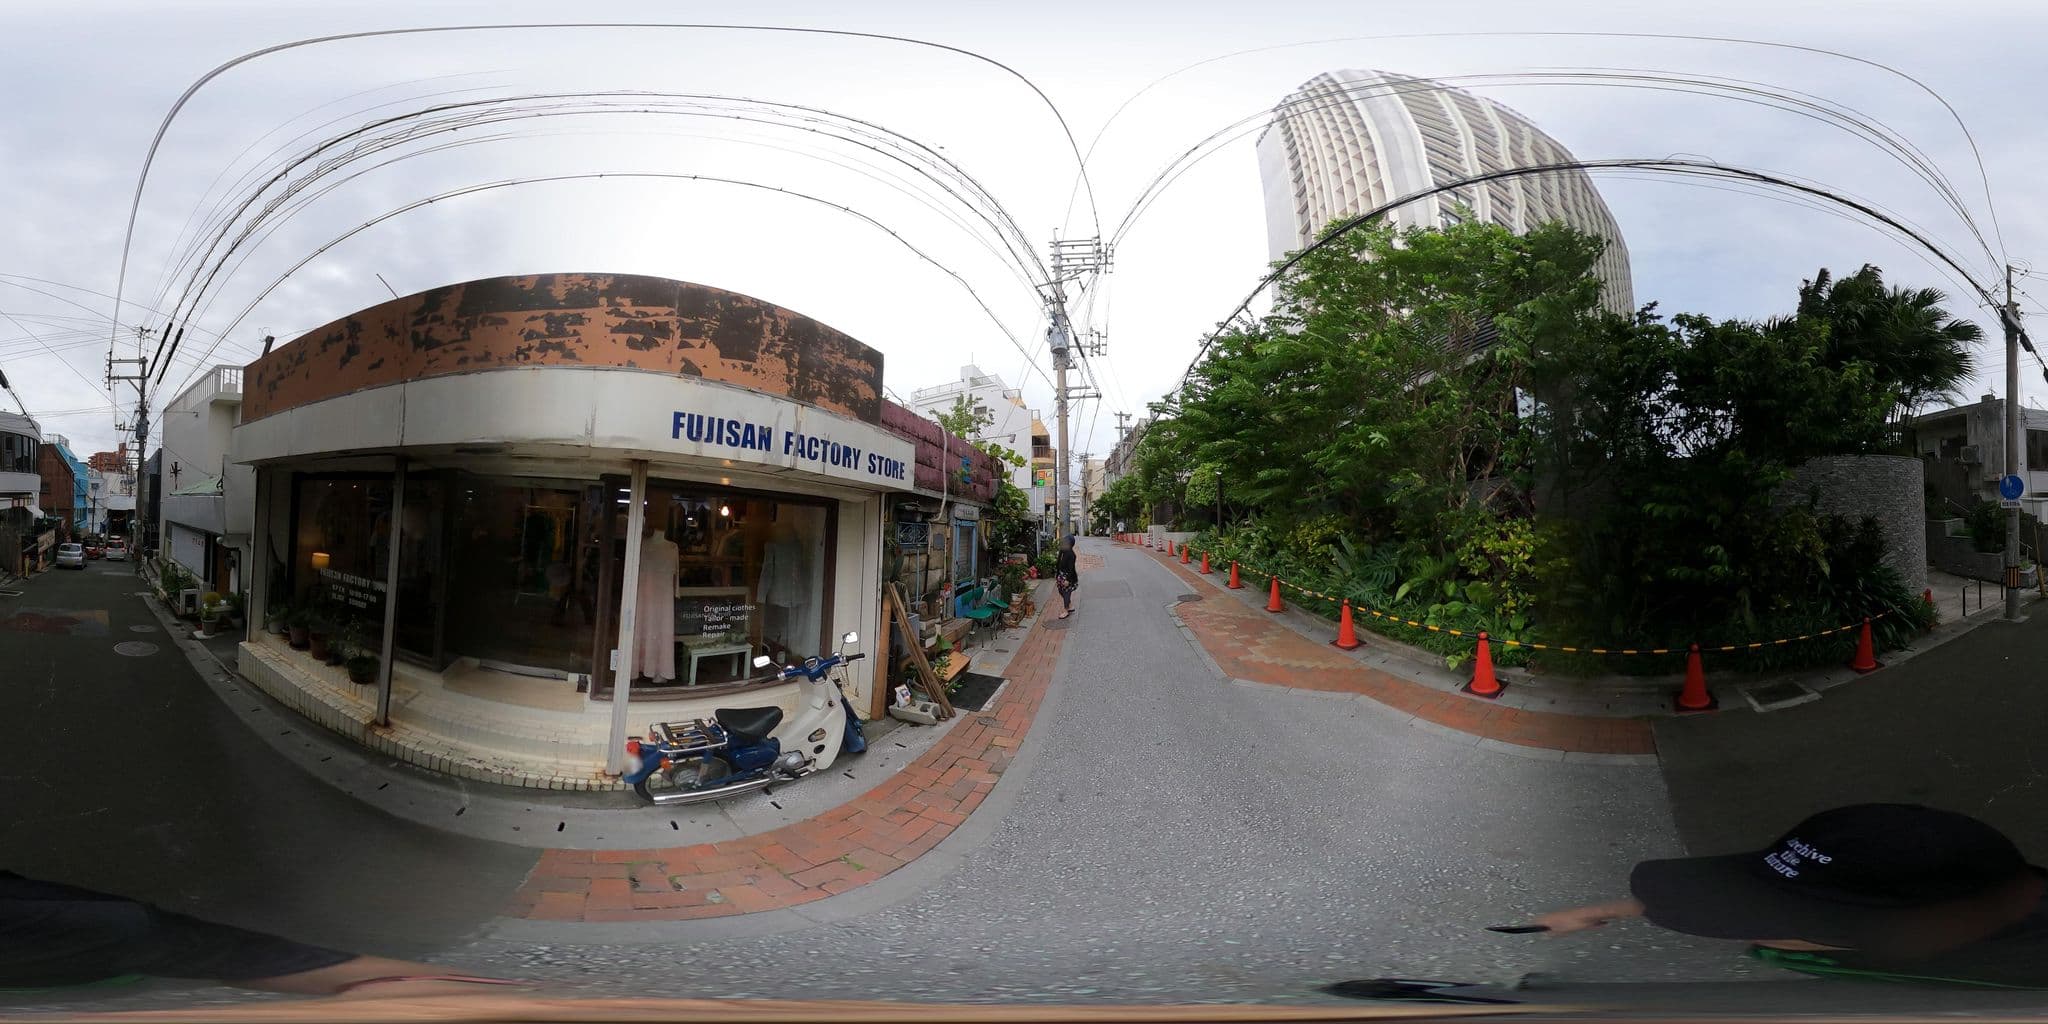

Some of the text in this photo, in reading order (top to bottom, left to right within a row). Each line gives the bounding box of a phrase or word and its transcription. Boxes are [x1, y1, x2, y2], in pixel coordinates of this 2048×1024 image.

[671, 411, 905, 481] FUJISAN FACTORY STORE
[704, 605, 731, 613] Original
[704, 614, 724, 622] Tailor
[703, 623, 731, 631] Remake
[702, 631, 725, 639] Repair
[1780, 850, 1801, 866] the
[1763, 852, 1800, 878] future
